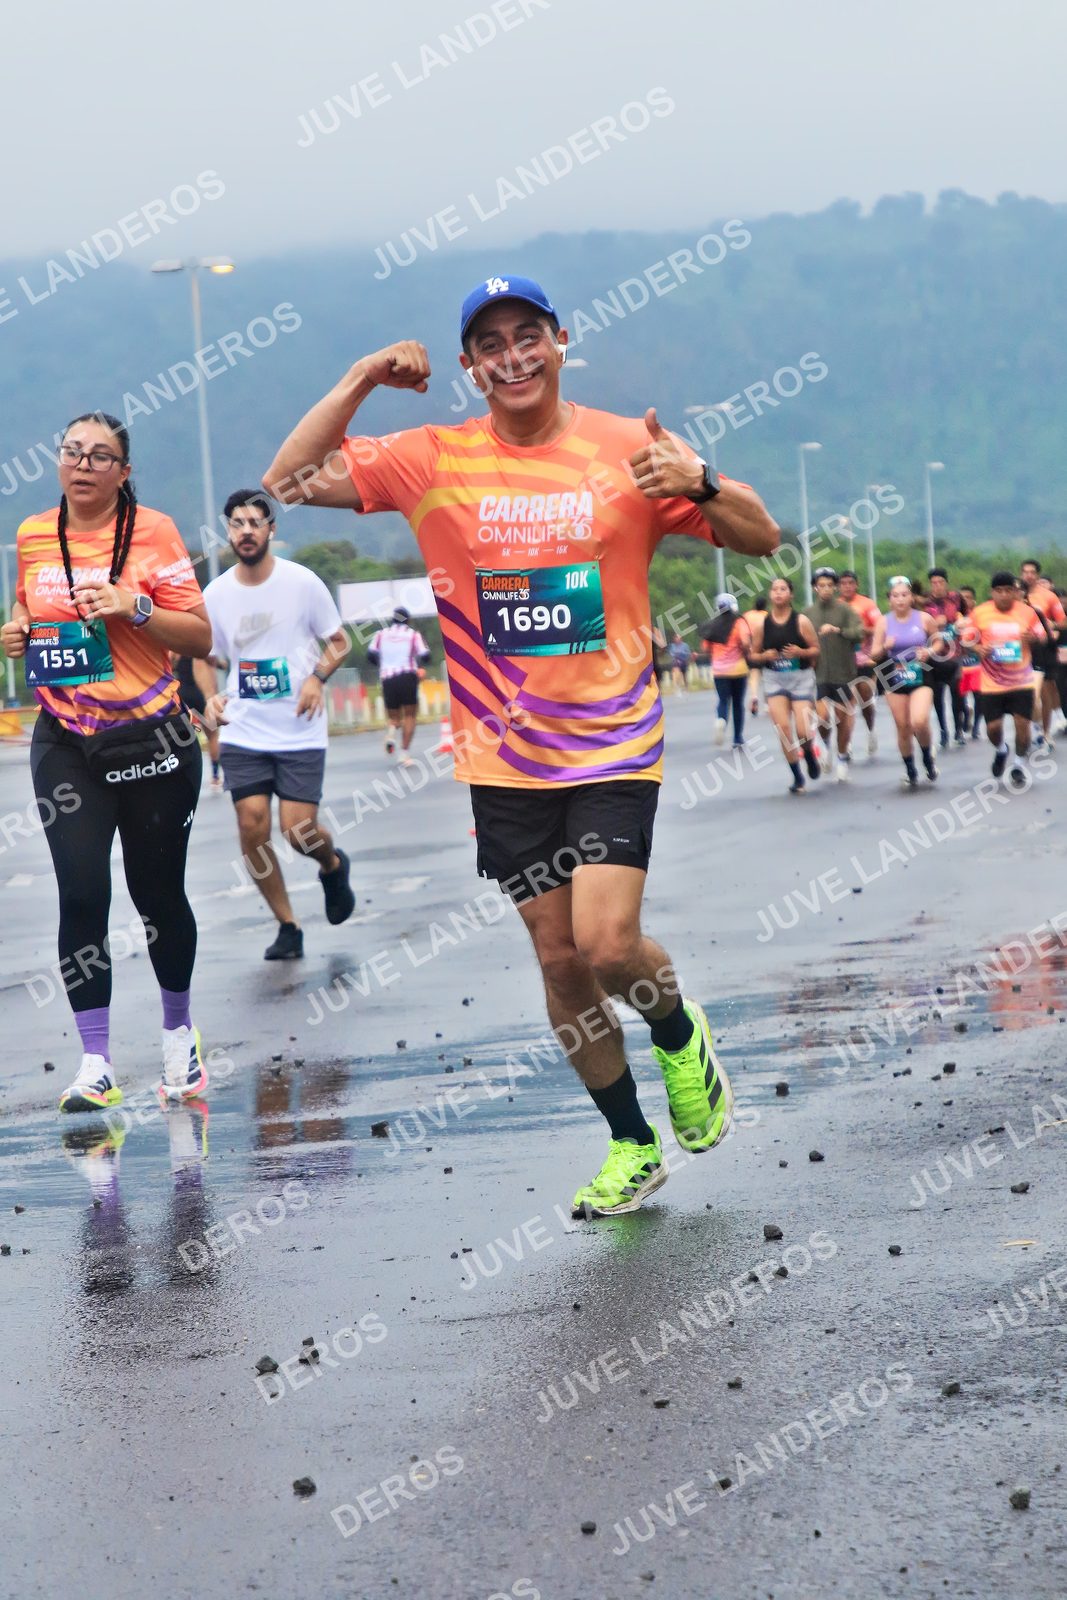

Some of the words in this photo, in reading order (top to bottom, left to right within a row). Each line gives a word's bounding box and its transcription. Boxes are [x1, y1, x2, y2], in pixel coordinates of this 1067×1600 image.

[478, 491, 593, 523] CARRERA
[482, 576, 530, 591] CARRERA
[565, 570, 589, 590] 10K
[482, 590, 518, 600] OMNILIFE
[497, 604, 571, 632] 1690
[40, 648, 88, 669] 1551
[106, 754, 180, 782] adidas
